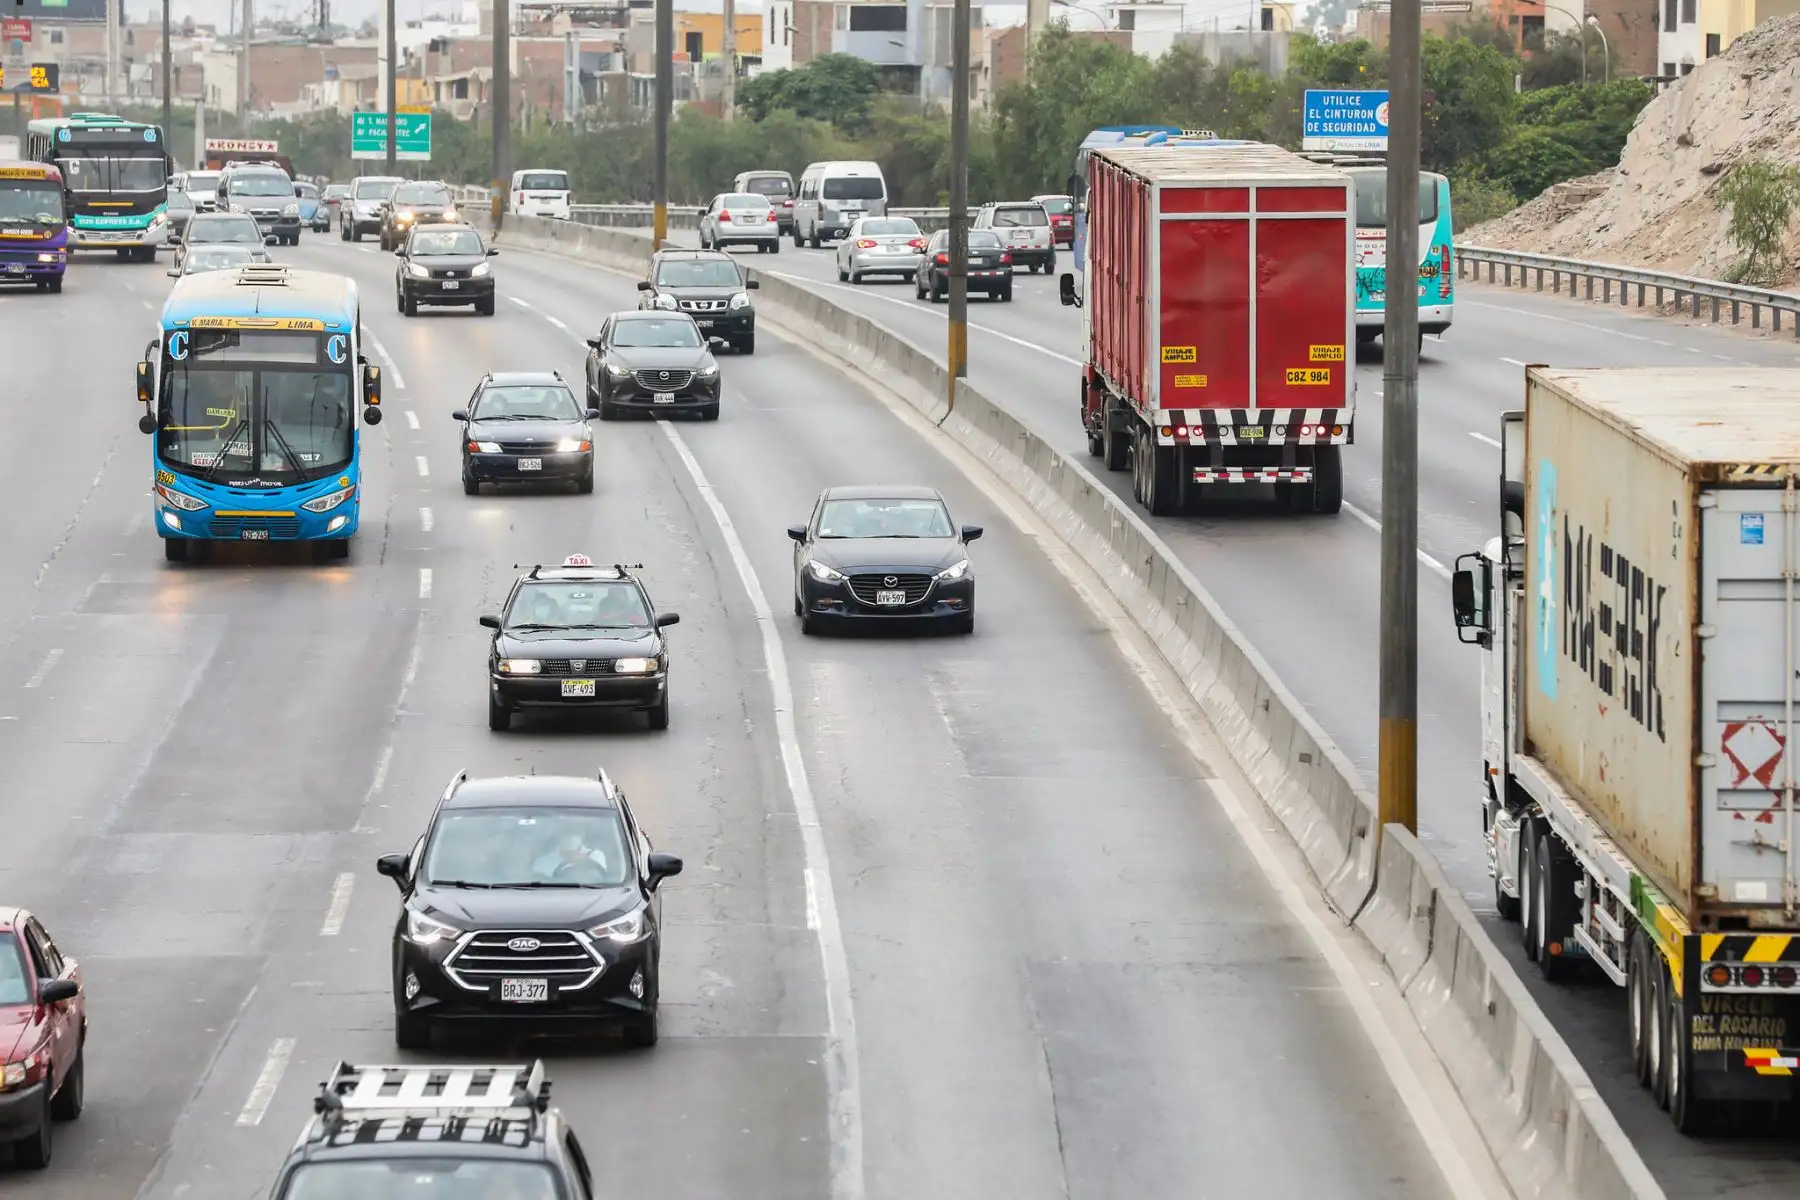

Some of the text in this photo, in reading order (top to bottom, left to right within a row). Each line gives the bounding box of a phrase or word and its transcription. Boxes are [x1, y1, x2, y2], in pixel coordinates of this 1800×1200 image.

[1323, 96, 1361, 106] UTILICE
[1309, 109, 1374, 119] EL CINTURON
[1307, 123, 1376, 132] DE SEGURIDAD
[287, 321, 313, 329] LIMA
[168, 332, 189, 360] C
[327, 335, 347, 364] C
[1287, 371, 1329, 382] C8Z 984
[510, 940, 538, 949] JAC
[503, 984, 546, 998] BRJ-377
[1701, 995, 1773, 1013] VIRGEN
[1692, 1015, 1786, 1037] DEL ROSARIO
